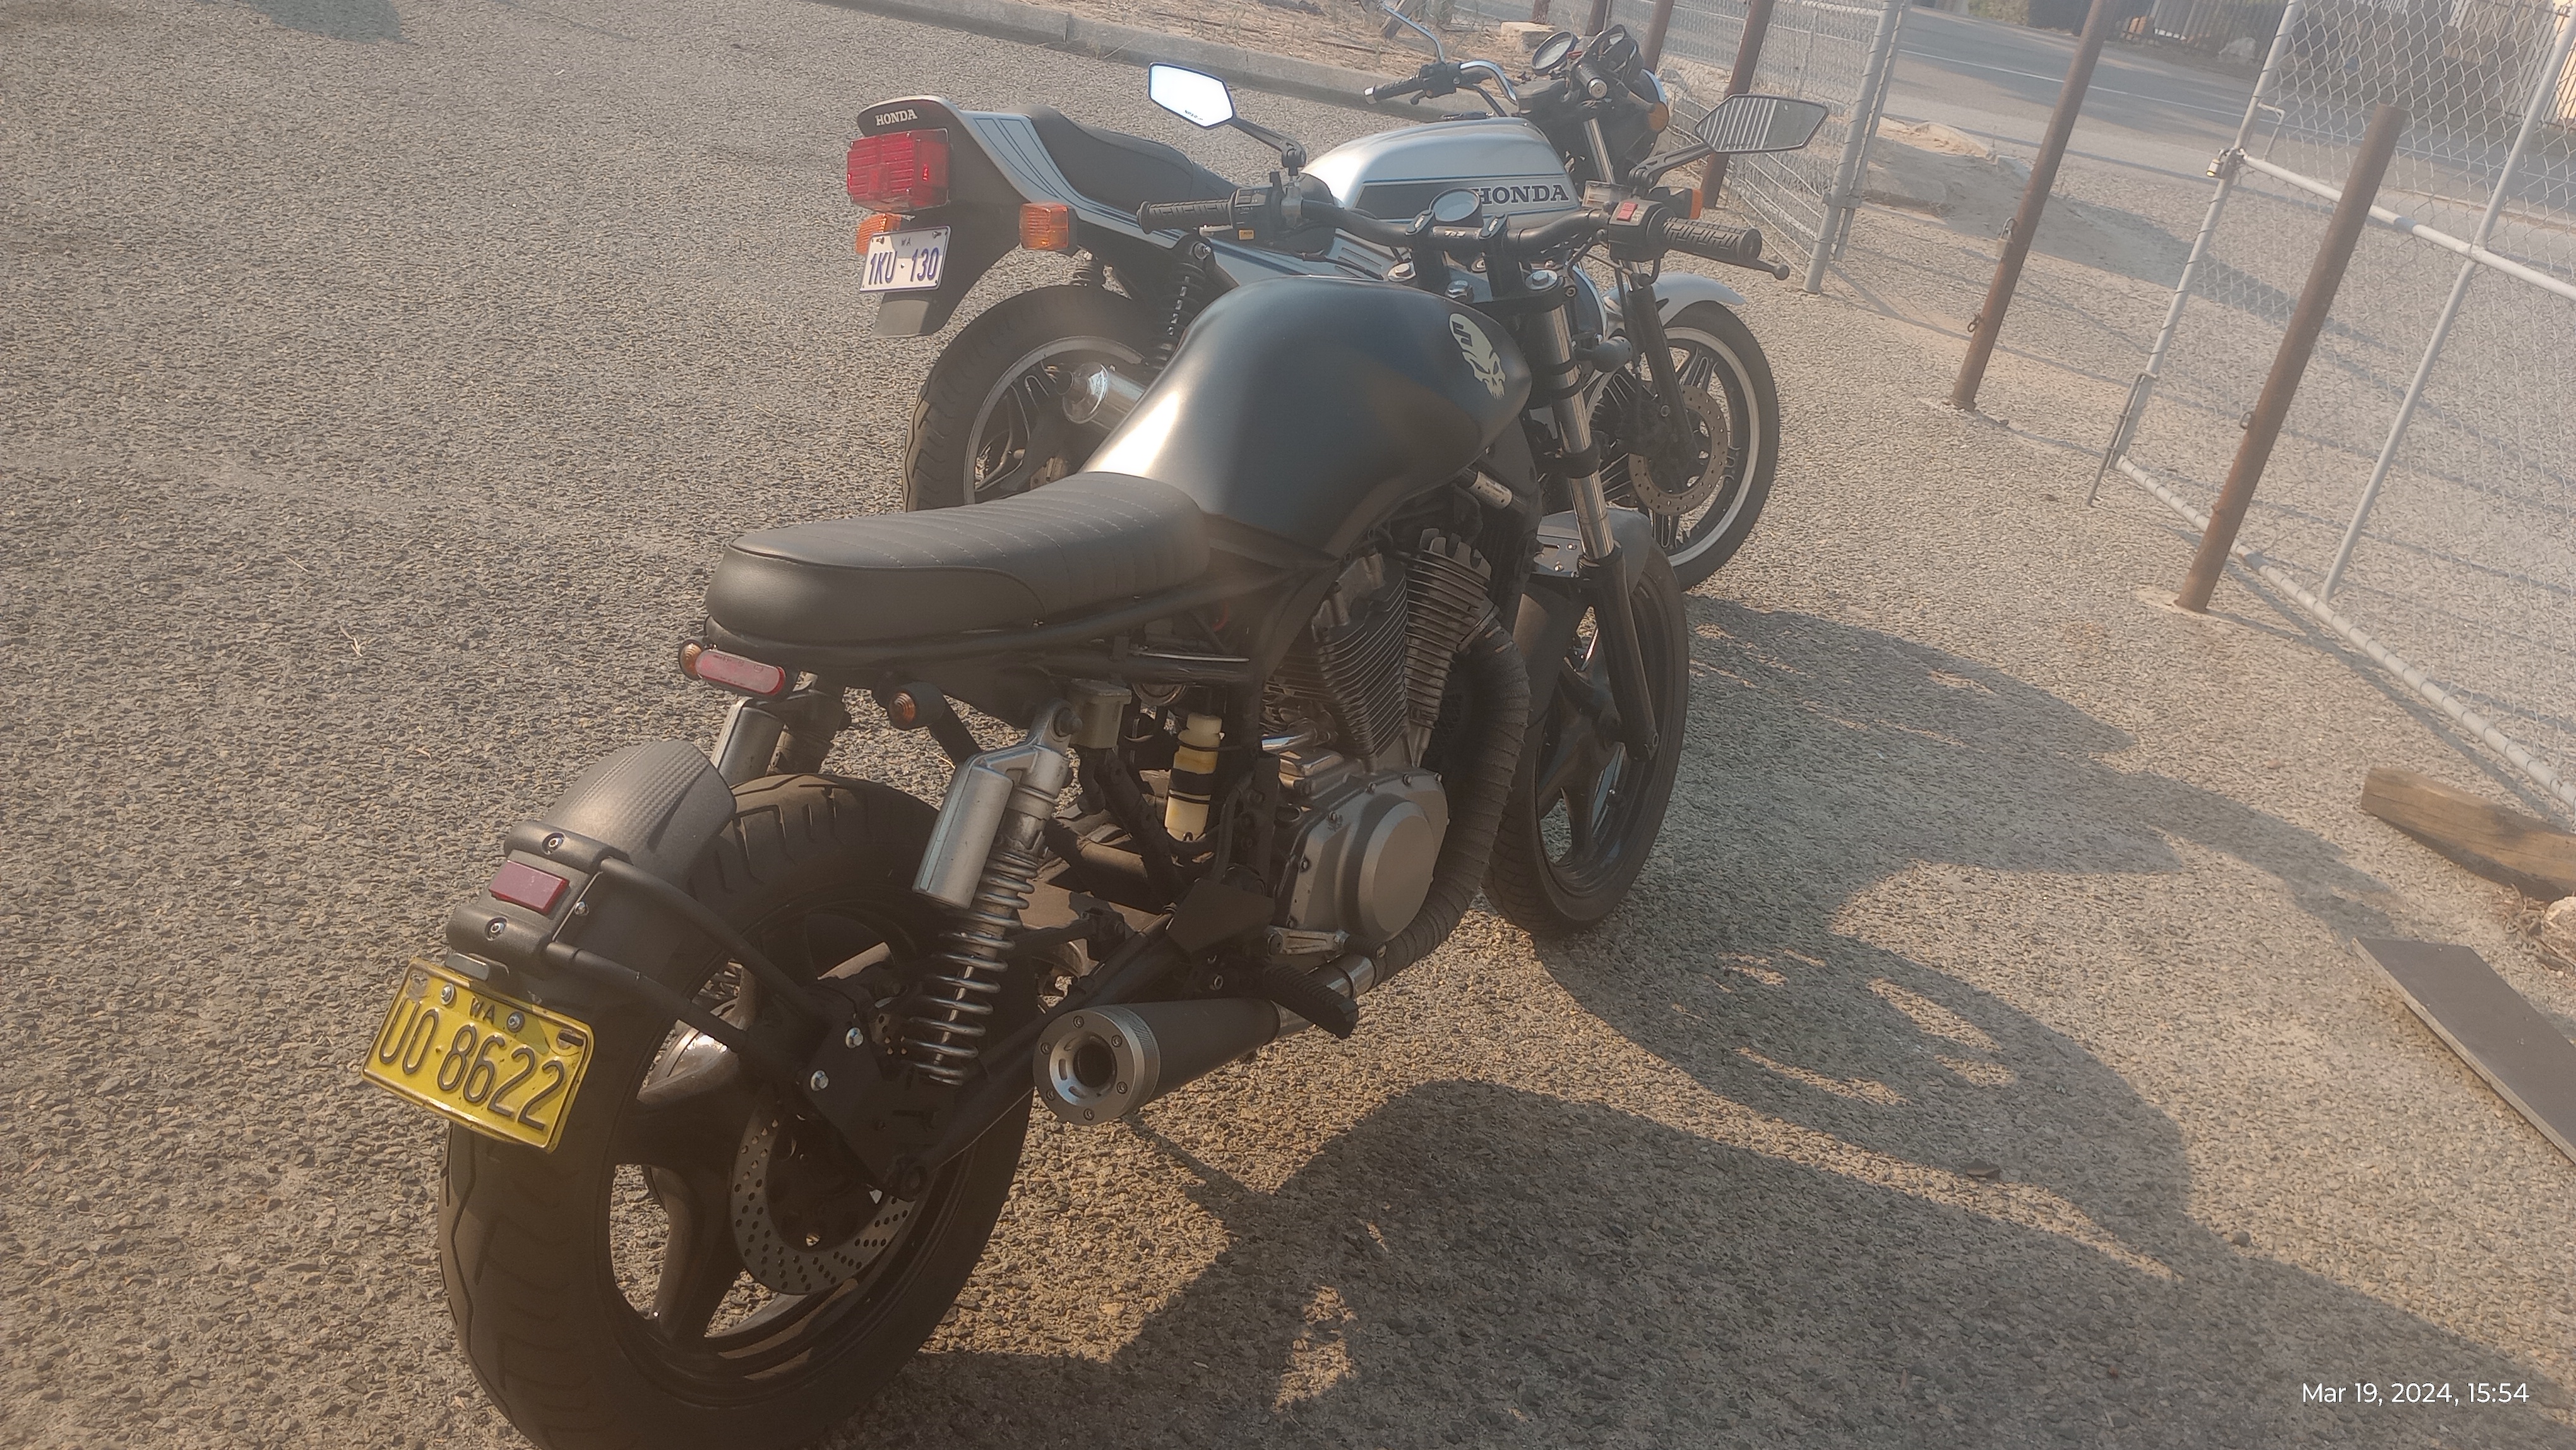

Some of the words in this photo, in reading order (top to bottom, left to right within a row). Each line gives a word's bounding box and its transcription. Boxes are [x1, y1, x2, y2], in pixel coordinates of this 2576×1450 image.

[875, 109, 917, 126] HONDA
[901, 237, 911, 246] WA
[469, 998, 496, 1024] WA
